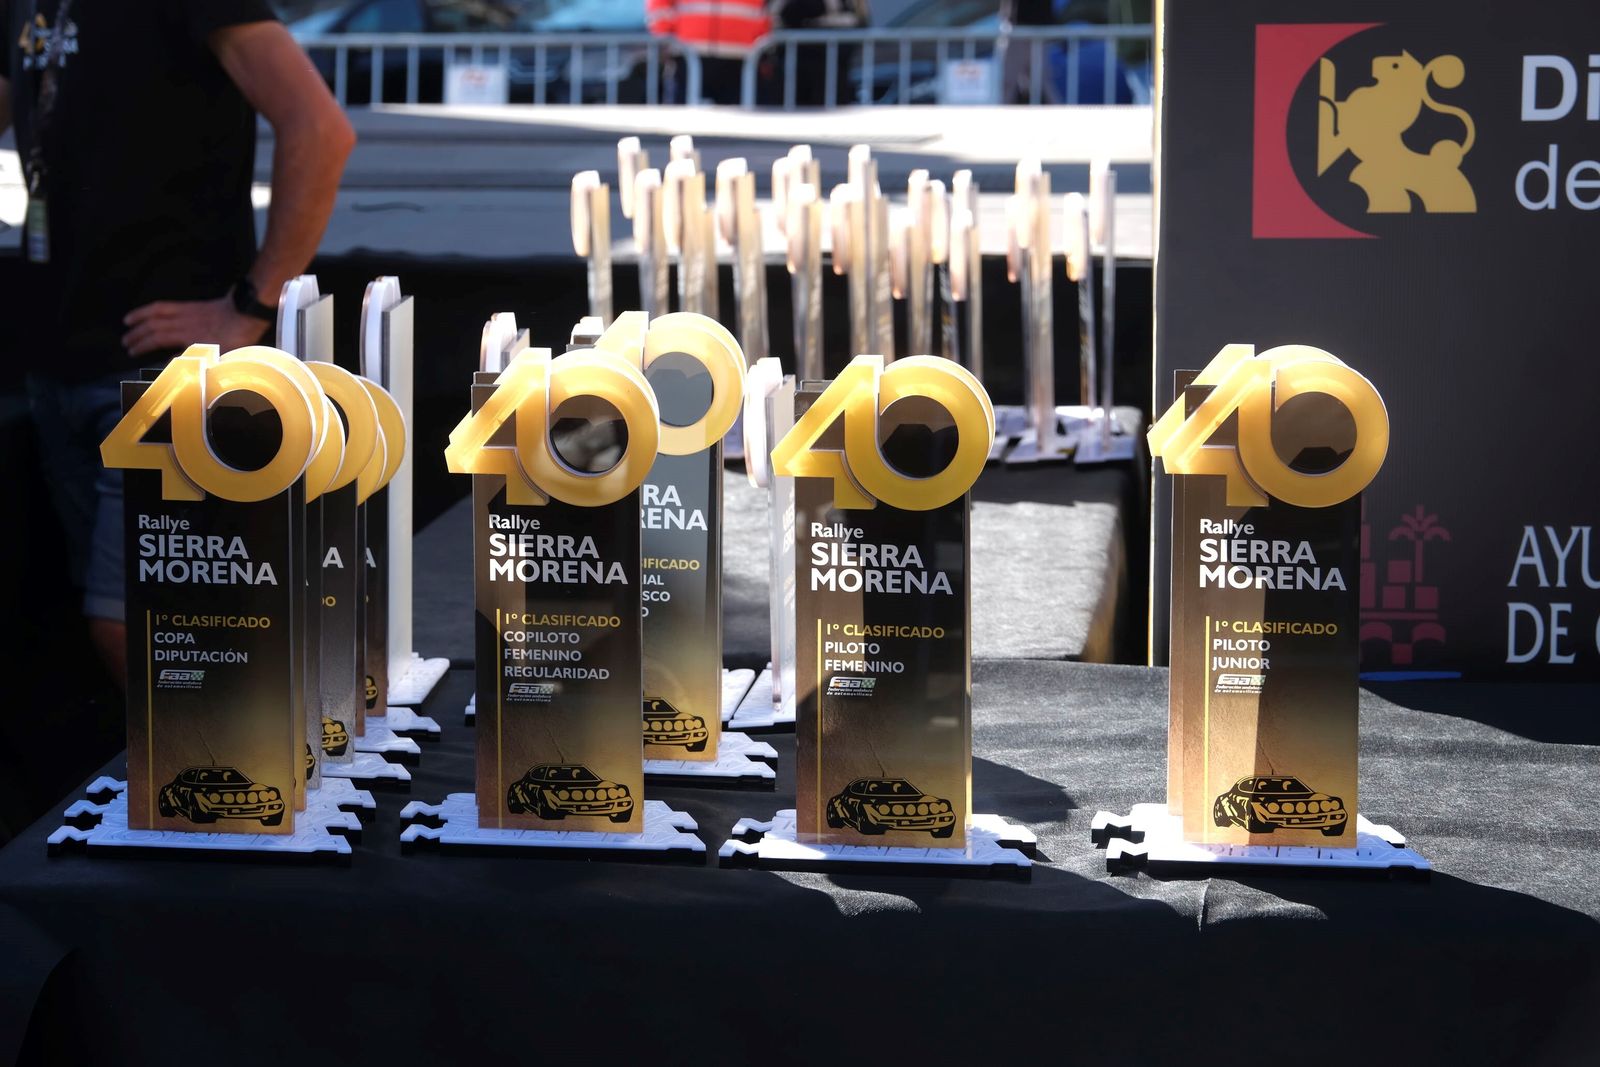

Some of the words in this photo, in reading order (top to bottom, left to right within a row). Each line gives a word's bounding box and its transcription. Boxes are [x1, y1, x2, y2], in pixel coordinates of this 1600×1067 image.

[1521, 55, 1600, 121] Di
[100, 357, 316, 502] 40
[445, 348, 660, 507] 40
[770, 355, 995, 511] 40
[1161, 358, 1390, 508] 40
[138, 514, 190, 533] Rallye
[488, 514, 541, 533] Rallye
[811, 522, 864, 542] Rallye
[1199, 518, 1255, 539] Rallye
[139, 534, 249, 559] SIERRA
[489, 533, 600, 559] SIERRA
[811, 542, 924, 568] SIERRA
[1200, 538, 1317, 565] SIERRA
[139, 559, 278, 585] MORENA
[489, 558, 629, 585] MORENA
[811, 568, 954, 595] MORENA
[1199, 564, 1347, 591] MORENA
[172, 615, 271, 629] CLASIFICADO
[522, 614, 621, 628] CLASIFICADO
[843, 624, 945, 638] CLASIFICADO
[1232, 621, 1338, 635] CLASIFICADO
[154, 632, 195, 644] COPA
[503, 631, 580, 644] COPILOTO
[1506, 602, 1575, 664] DE
[504, 648, 582, 661] FEMENINO
[825, 641, 880, 654] PILOTO
[1213, 639, 1271, 652] PILOTO
[154, 649, 248, 663] DIPUTACIÓN
[825, 659, 905, 673] FEMENINO
[1212, 656, 1270, 671] JUNIOR
[504, 666, 610, 680] REGULARIDAD
